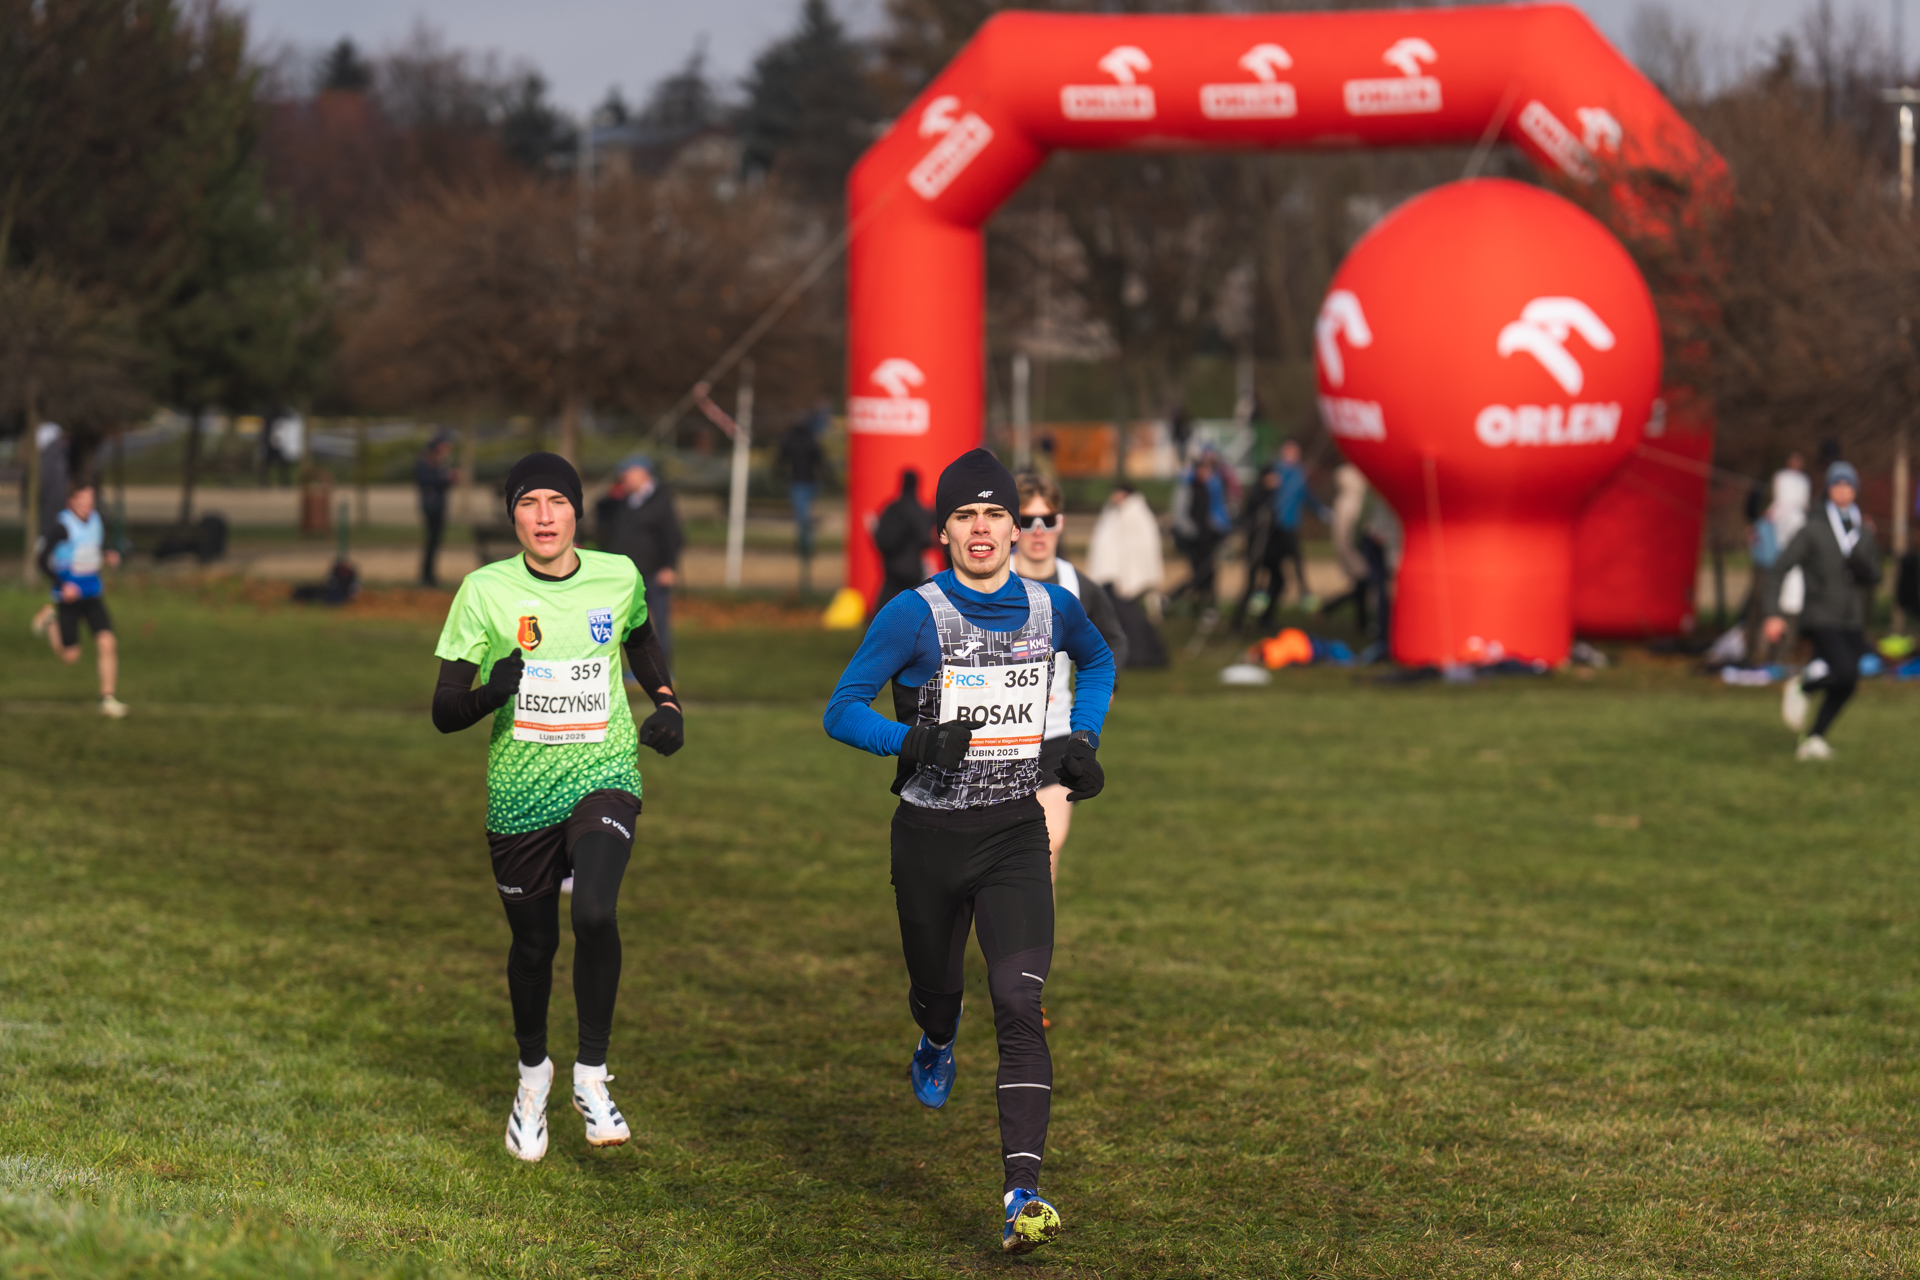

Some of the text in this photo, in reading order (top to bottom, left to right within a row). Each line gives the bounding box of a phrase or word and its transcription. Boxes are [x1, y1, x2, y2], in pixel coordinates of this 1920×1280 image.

[1474, 401, 1623, 447] ORLEN
[589, 614, 611, 624] STAL
[1029, 637, 1048, 650] KML
[571, 662, 602, 681] 359
[1004, 667, 1039, 688] 365
[518, 690, 606, 714] LESZCZYŃSKI
[956, 702, 1034, 725] BOSAK
[539, 733, 563, 741] LUBIN
[967, 748, 1019, 757] LUBIN 2025
